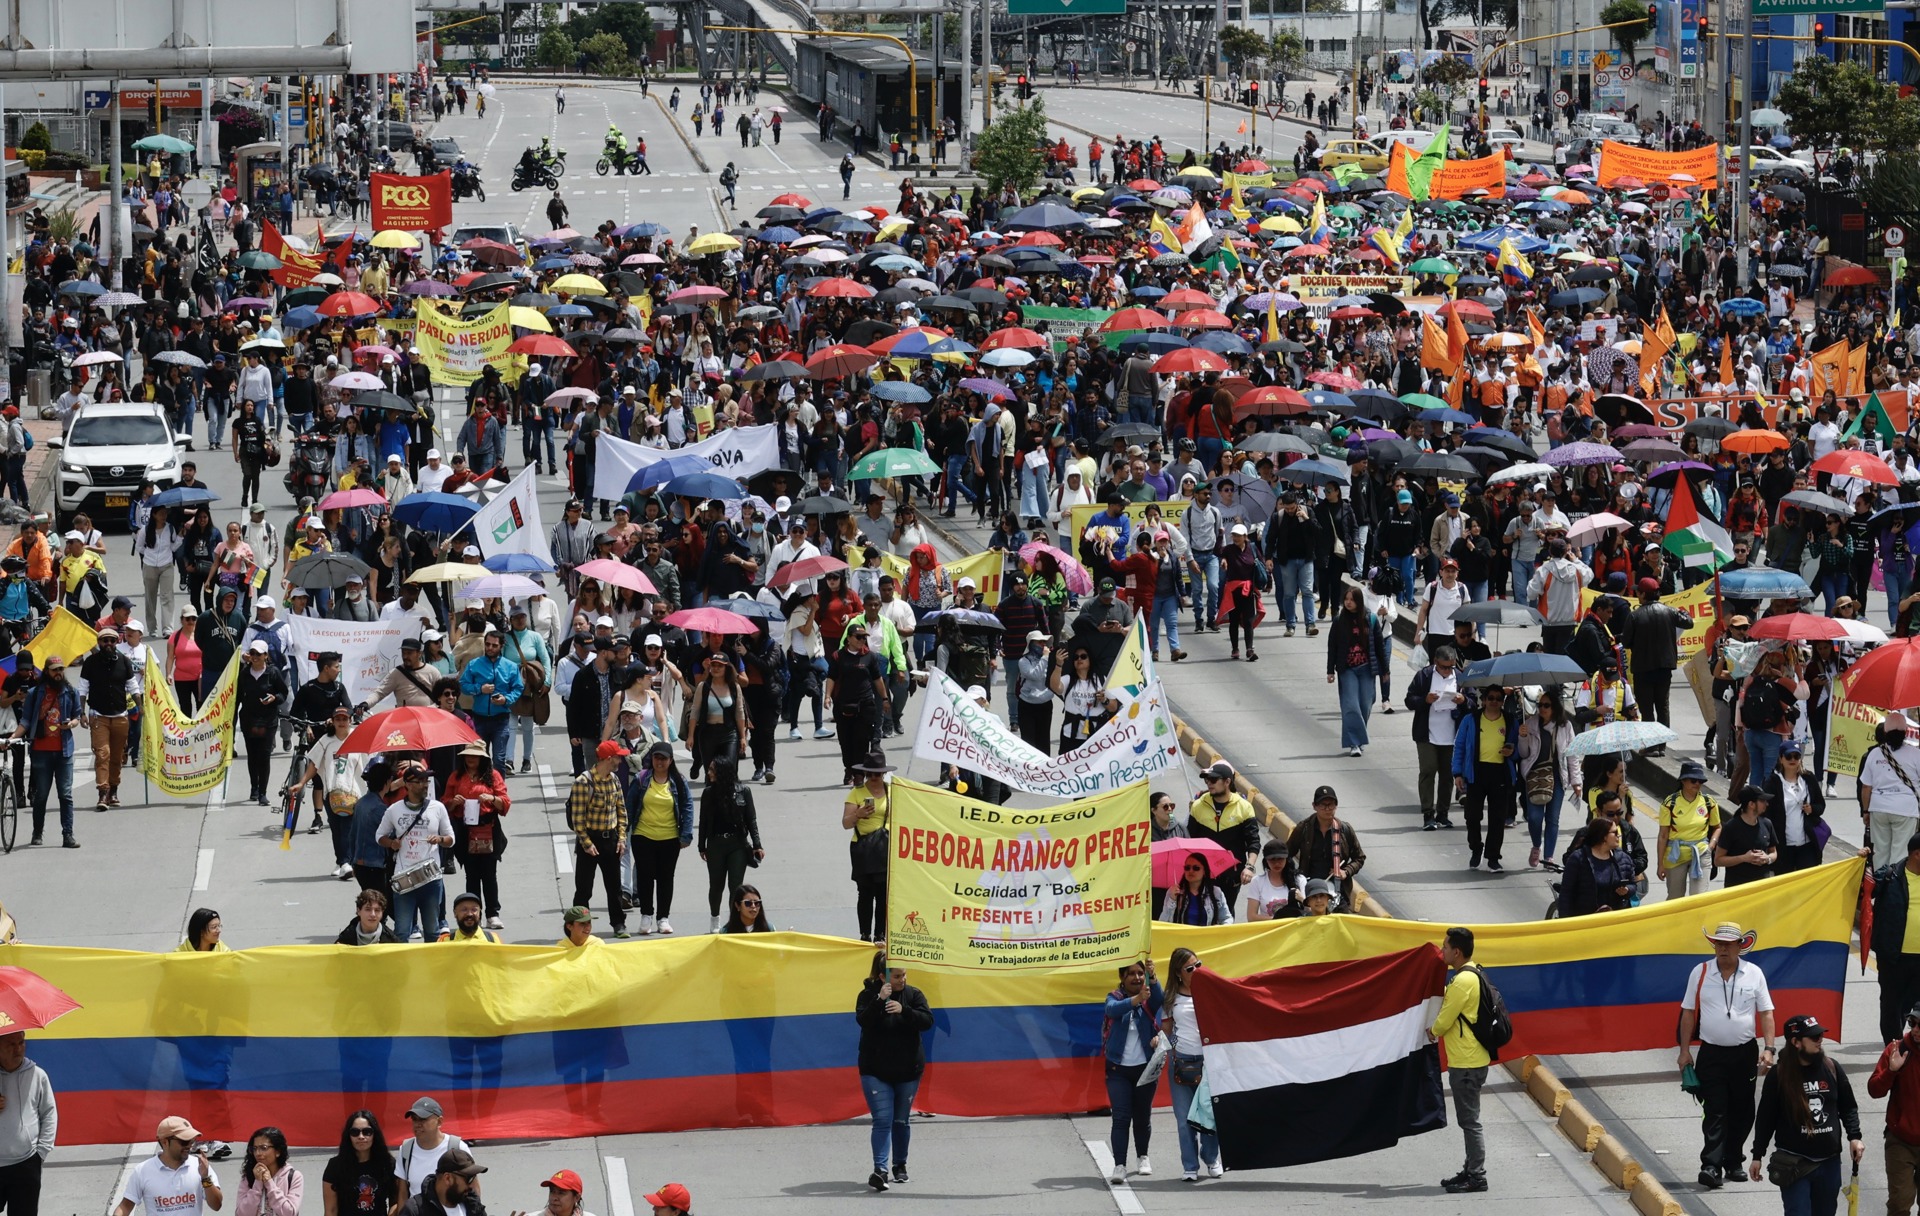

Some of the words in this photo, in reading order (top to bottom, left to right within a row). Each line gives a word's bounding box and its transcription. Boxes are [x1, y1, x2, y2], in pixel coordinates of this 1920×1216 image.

[1556, 94, 1567, 102] 50
[1300, 276, 1342, 286] DOCENTES
[418, 319, 456, 346] PABLO
[459, 322, 510, 347] NERUDA
[960, 806, 1004, 824] I.E.D.
[1012, 807, 1096, 825] COLEGIO
[899, 826, 984, 870] DEBORA
[991, 837, 1080, 872] ARANGO
[1085, 821, 1150, 865] PEREZ
[954, 883, 1027, 898] Localidad
[1032, 885, 1041, 897] 7
[952, 906, 1033, 924] PRESENTE
[1062, 892, 1141, 918] PRESENTE
[968, 940, 1018, 950] Asociación
[1020, 939, 1057, 950] Distrital
[1059, 939, 1071, 947] de
[1073, 929, 1130, 946] Trabajadores
[890, 945, 944, 960] Educación
[980, 956, 984, 964] y
[988, 954, 1047, 966] Trabajadoras
[1048, 953, 1059, 962] de
[1061, 952, 1070, 961] la
[1072, 946, 1120, 960] Educación
